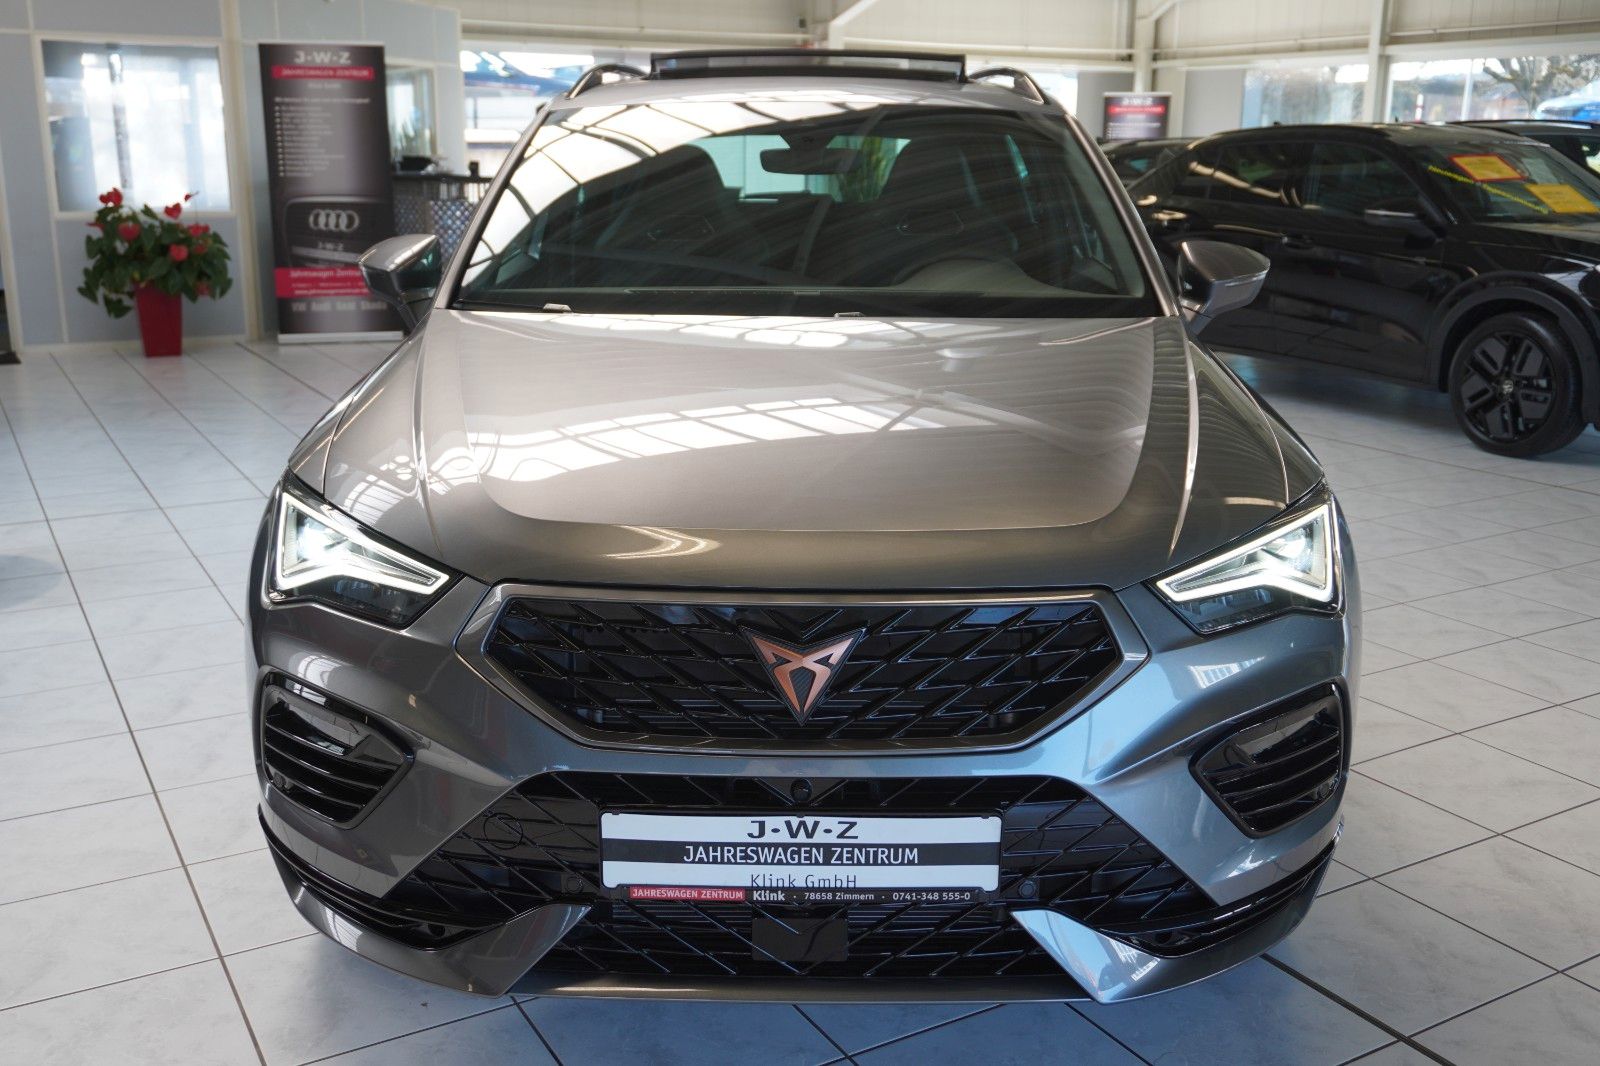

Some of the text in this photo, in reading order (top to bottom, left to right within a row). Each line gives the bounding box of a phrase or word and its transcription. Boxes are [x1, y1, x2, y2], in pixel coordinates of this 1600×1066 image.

[683, 845, 918, 864] JAHRESWAGEN ZENTRUM
[750, 873, 857, 888] Klink GmbH
[632, 888, 743, 899] JAHRESWAGEN ZENTRUM
[753, 890, 971, 901] Klink 78658 Zimmern 0741-348 555-0
